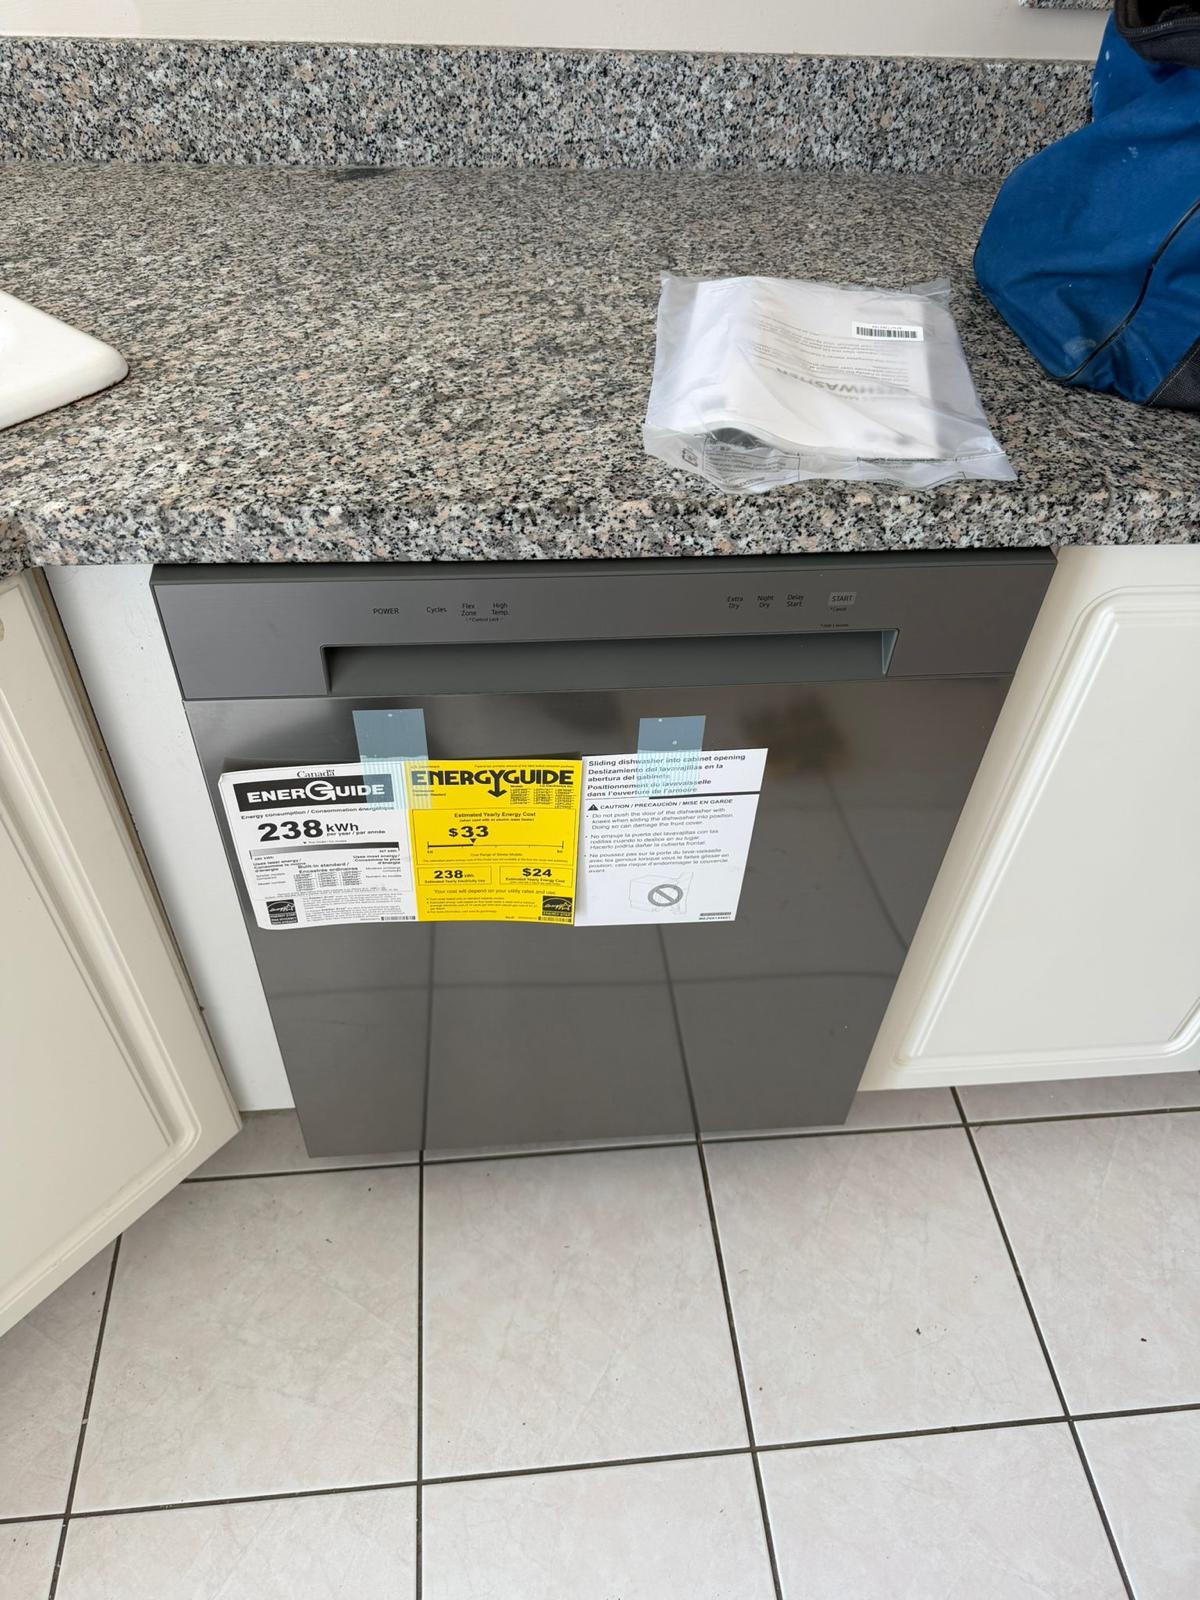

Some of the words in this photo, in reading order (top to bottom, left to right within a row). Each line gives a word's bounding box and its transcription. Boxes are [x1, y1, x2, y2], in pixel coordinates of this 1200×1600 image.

[426, 606, 447, 614] Cycles
[714, 754, 745, 762] opening
[296, 770, 335, 778] Canada
[411, 770, 574, 787] ENERGYGUIDE
[247, 780, 385, 803] ENERGUIDE
[258, 820, 323, 842] 238
[326, 823, 358, 832] kWh
[449, 826, 489, 838] $33
[434, 870, 463, 879] 238
[523, 868, 552, 877] $24
